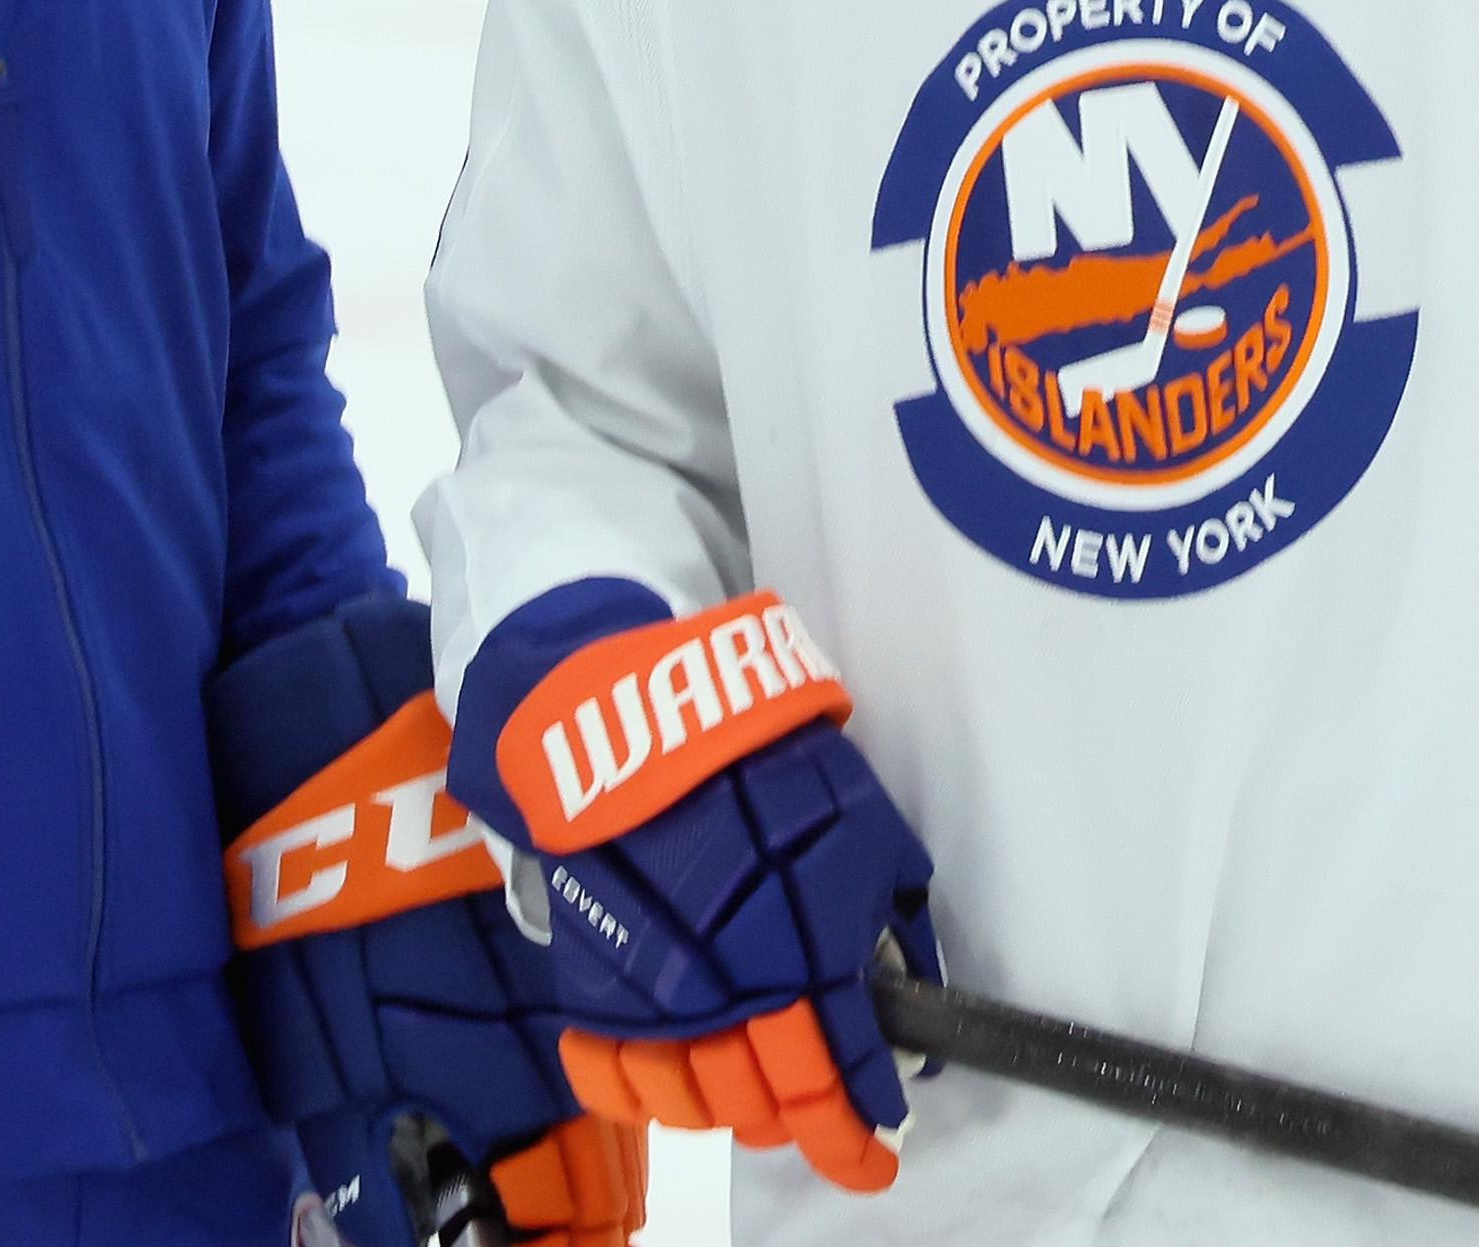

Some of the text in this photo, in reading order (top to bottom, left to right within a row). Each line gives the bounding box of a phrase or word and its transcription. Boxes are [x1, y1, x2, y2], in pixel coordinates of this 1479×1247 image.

[1216, 0, 1286, 55] OF
[1002, 81, 1240, 261] NY
[985, 284, 1292, 463] ISLANDERS
[1030, 474, 1295, 584] NEW YORK
[551, 865, 630, 948] COVERT
